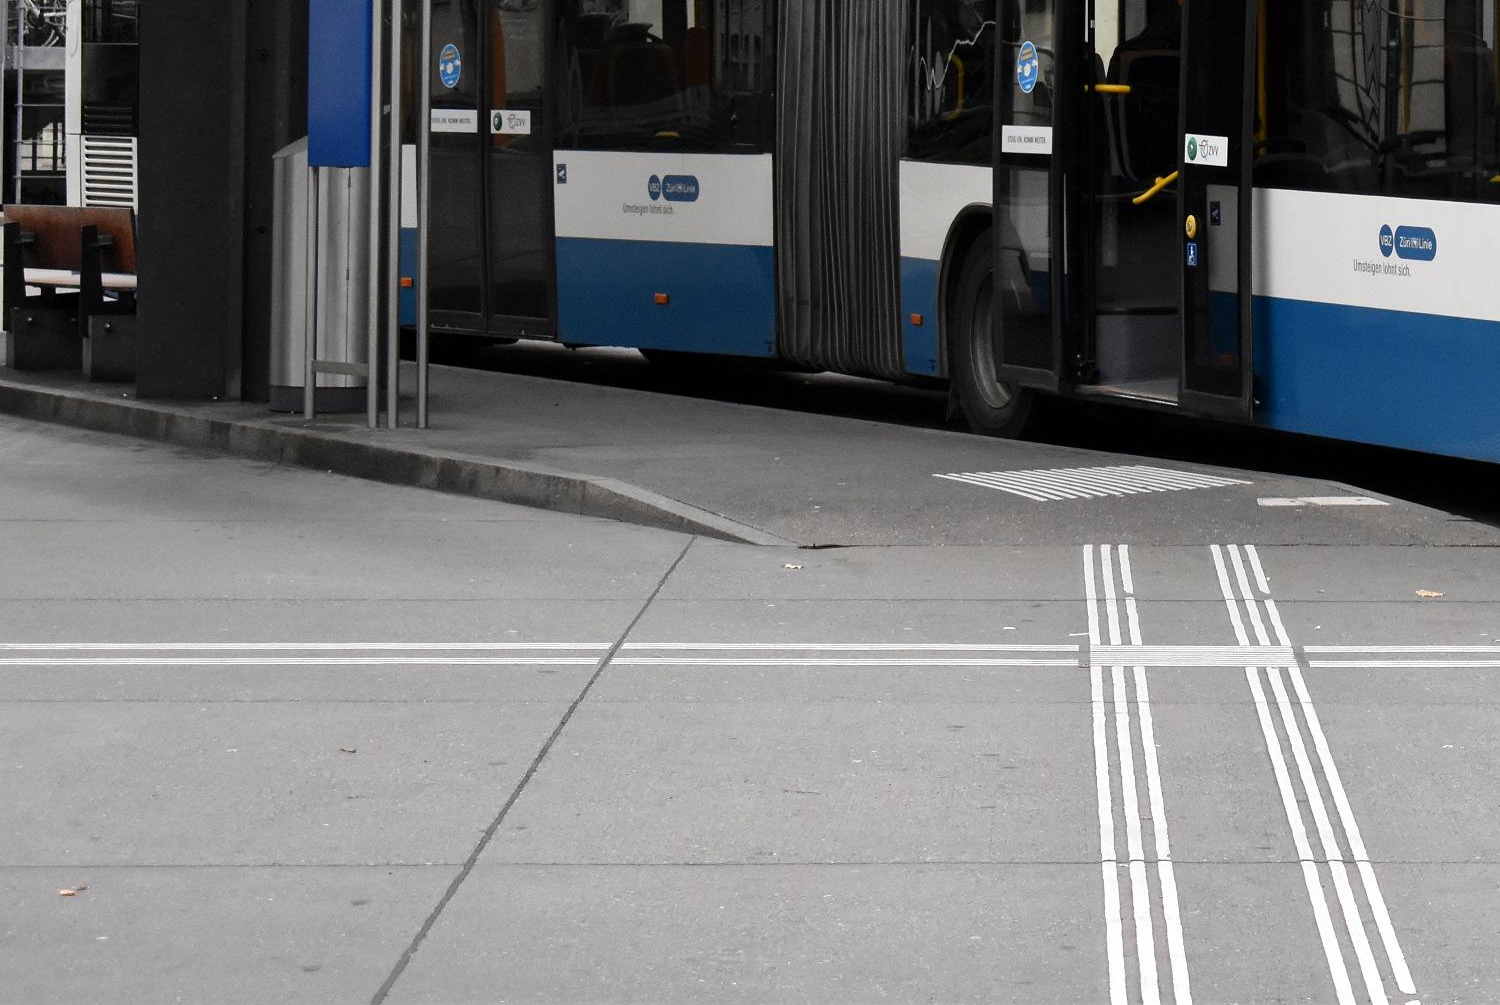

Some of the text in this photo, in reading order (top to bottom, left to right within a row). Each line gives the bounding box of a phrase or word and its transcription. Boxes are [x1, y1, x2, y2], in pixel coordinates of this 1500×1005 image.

[1208, 146, 1219, 156] ZVV
[1380, 234, 1393, 247] VBZ
[1419, 237, 1433, 250] Linie
[1353, 258, 1382, 276] Umsteigen
[1383, 262, 1397, 275] lohnt
